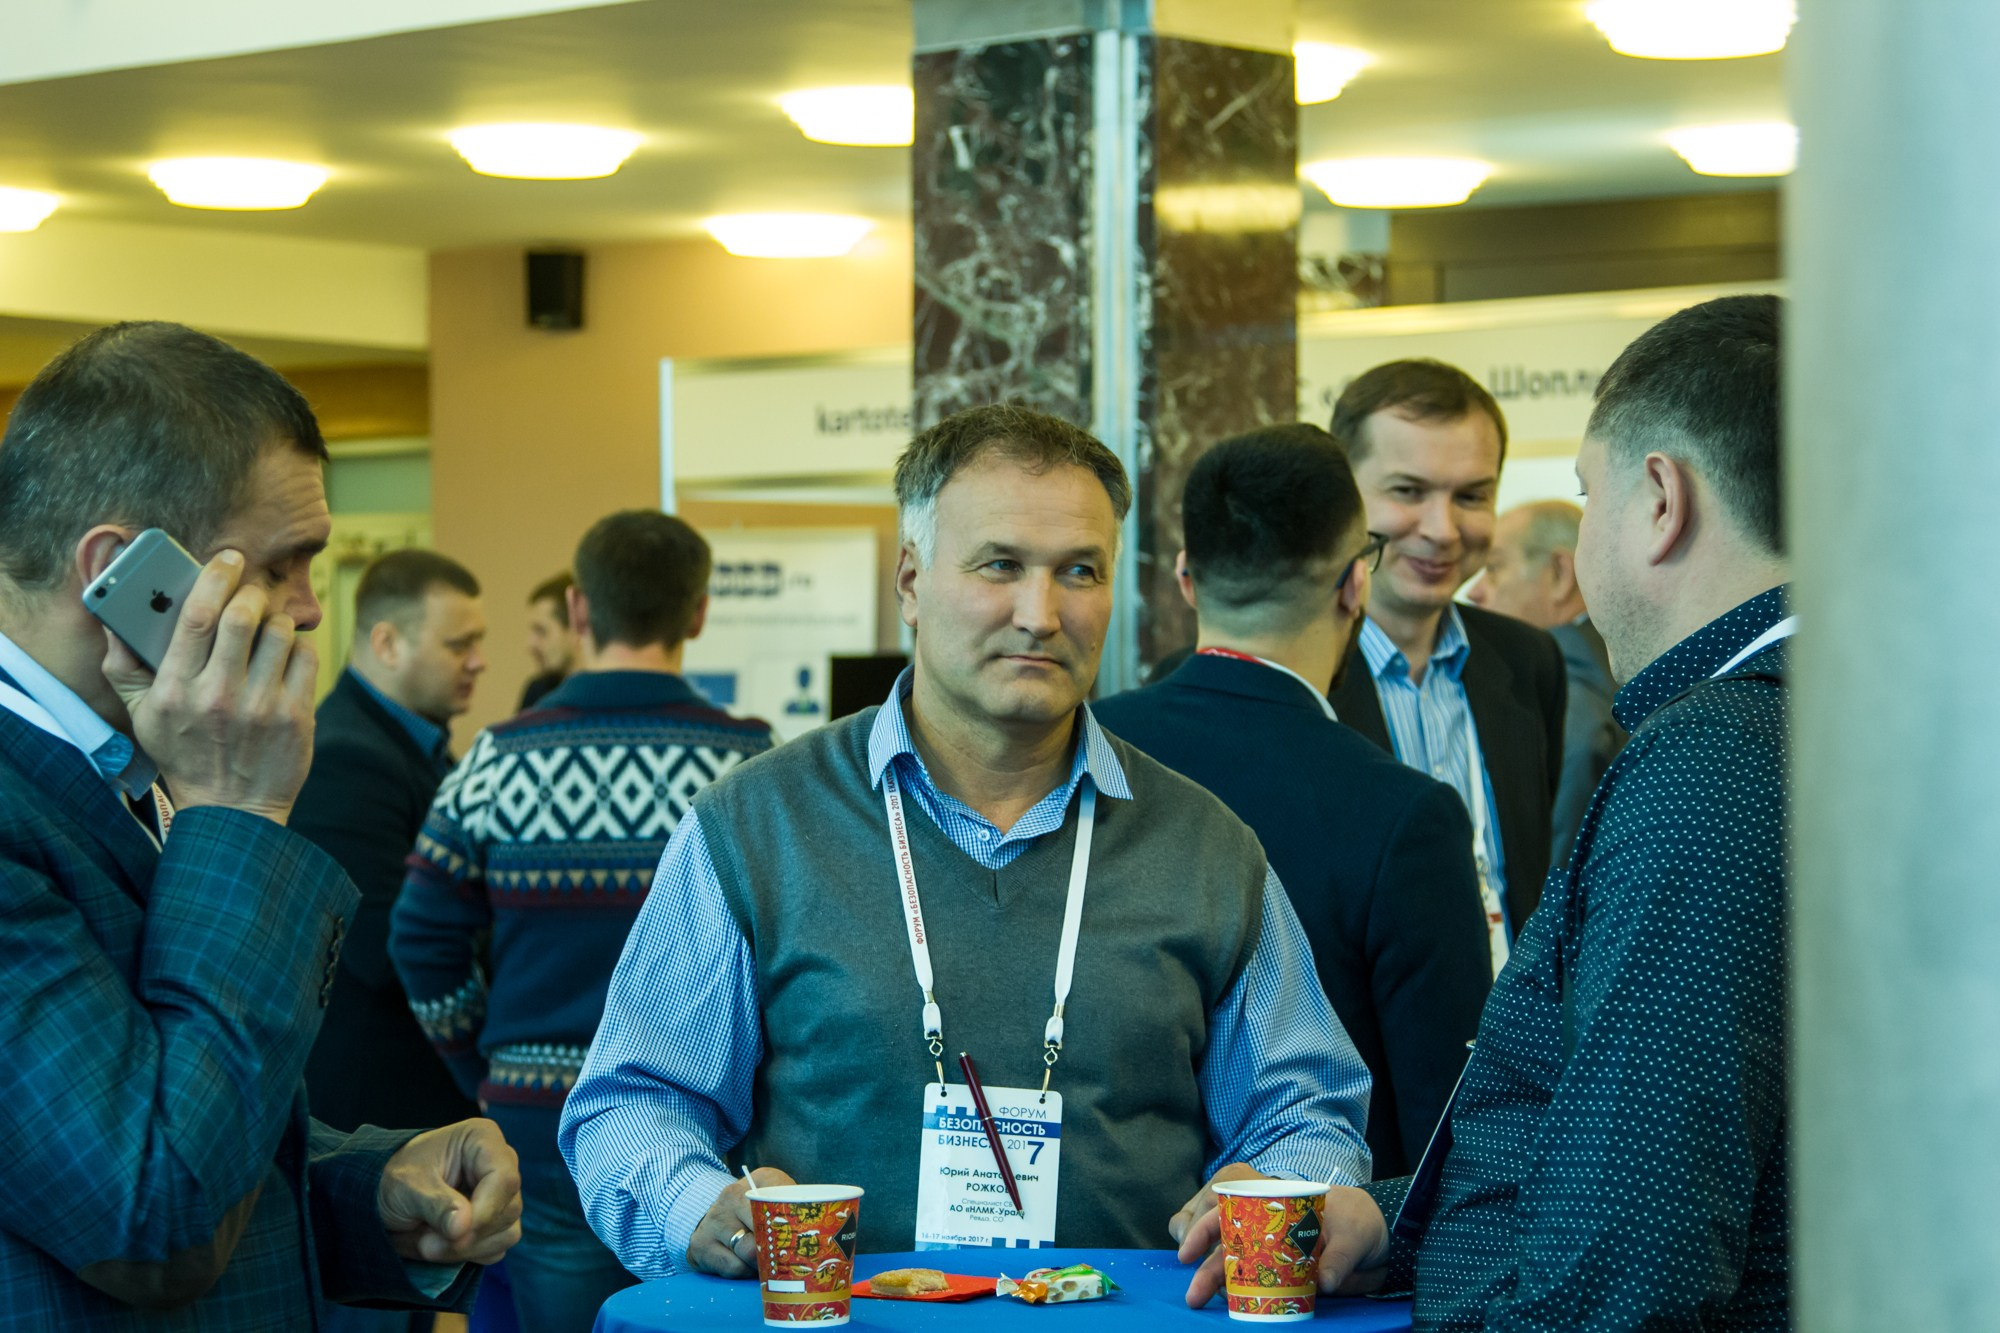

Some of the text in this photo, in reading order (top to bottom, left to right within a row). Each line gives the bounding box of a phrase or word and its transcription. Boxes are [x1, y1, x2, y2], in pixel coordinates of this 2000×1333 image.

[890, 795, 900, 810] 2017
[912, 916, 924, 945] ФОРУМ
[999, 1106, 1047, 1119] ФОРУМ
[938, 1117, 1046, 1136] БЕЗОПСНОСТЬ
[937, 1134, 1045, 1165] БИЗНЕС 2017
[940, 1166, 1039, 1182] Юрий Анатоевич
[949, 1204, 963, 1213] АО
[941, 1234, 967, 1244] ноября
[968, 1235, 984, 1243] 2017
[1297, 1228, 1319, 1238] RIOBA
